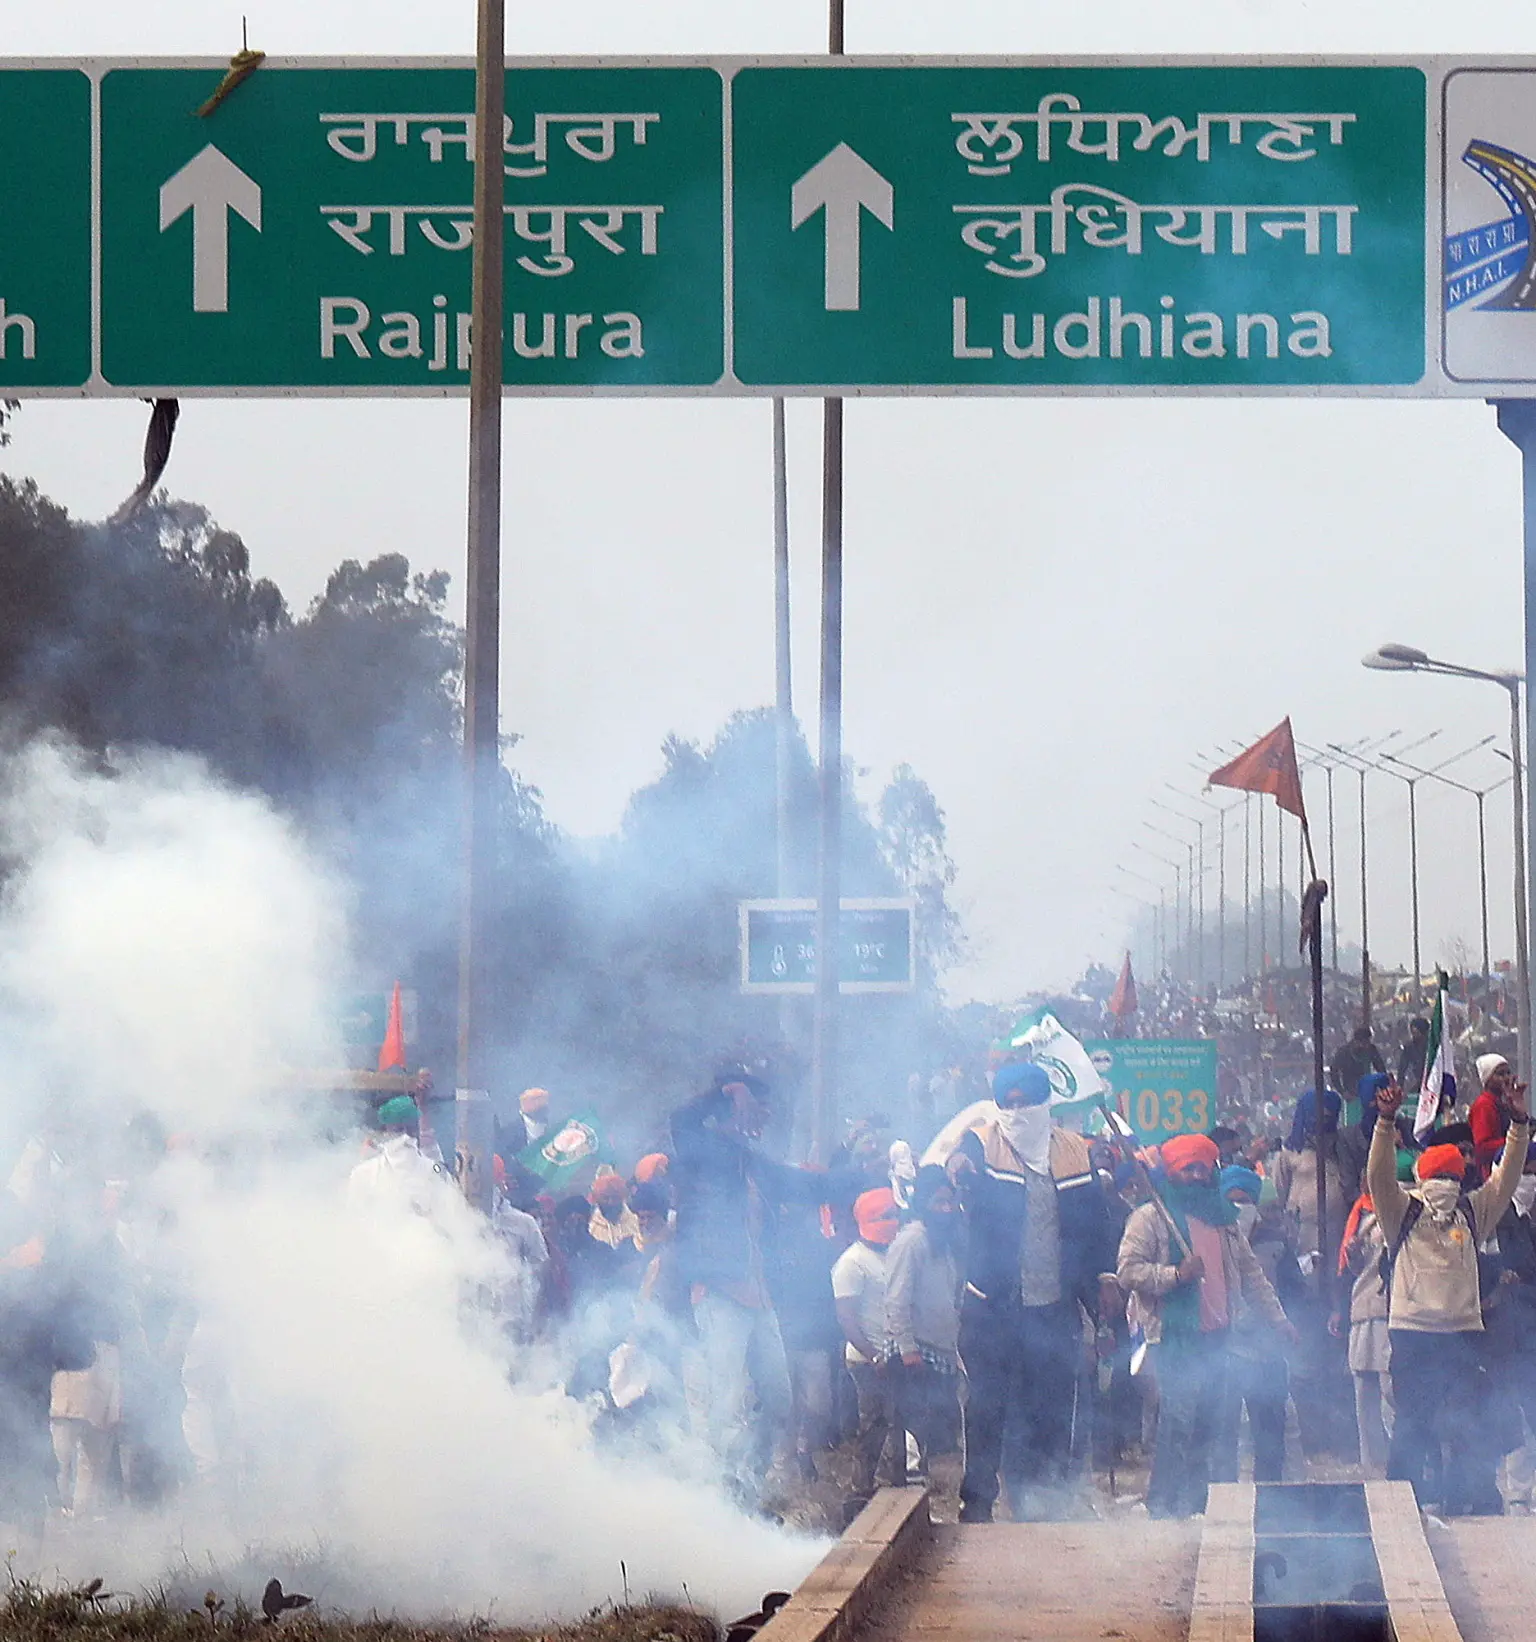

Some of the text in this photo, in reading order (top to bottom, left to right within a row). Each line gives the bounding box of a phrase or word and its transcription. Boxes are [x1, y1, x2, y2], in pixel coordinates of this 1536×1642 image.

[951, 93, 1356, 176] ਲੁਧਿਆਣਾ
[952, 183, 1359, 278] लुधियाना
[953, 296, 1333, 359] Ludhiana
[1119, 1088, 1208, 1131] 1033
